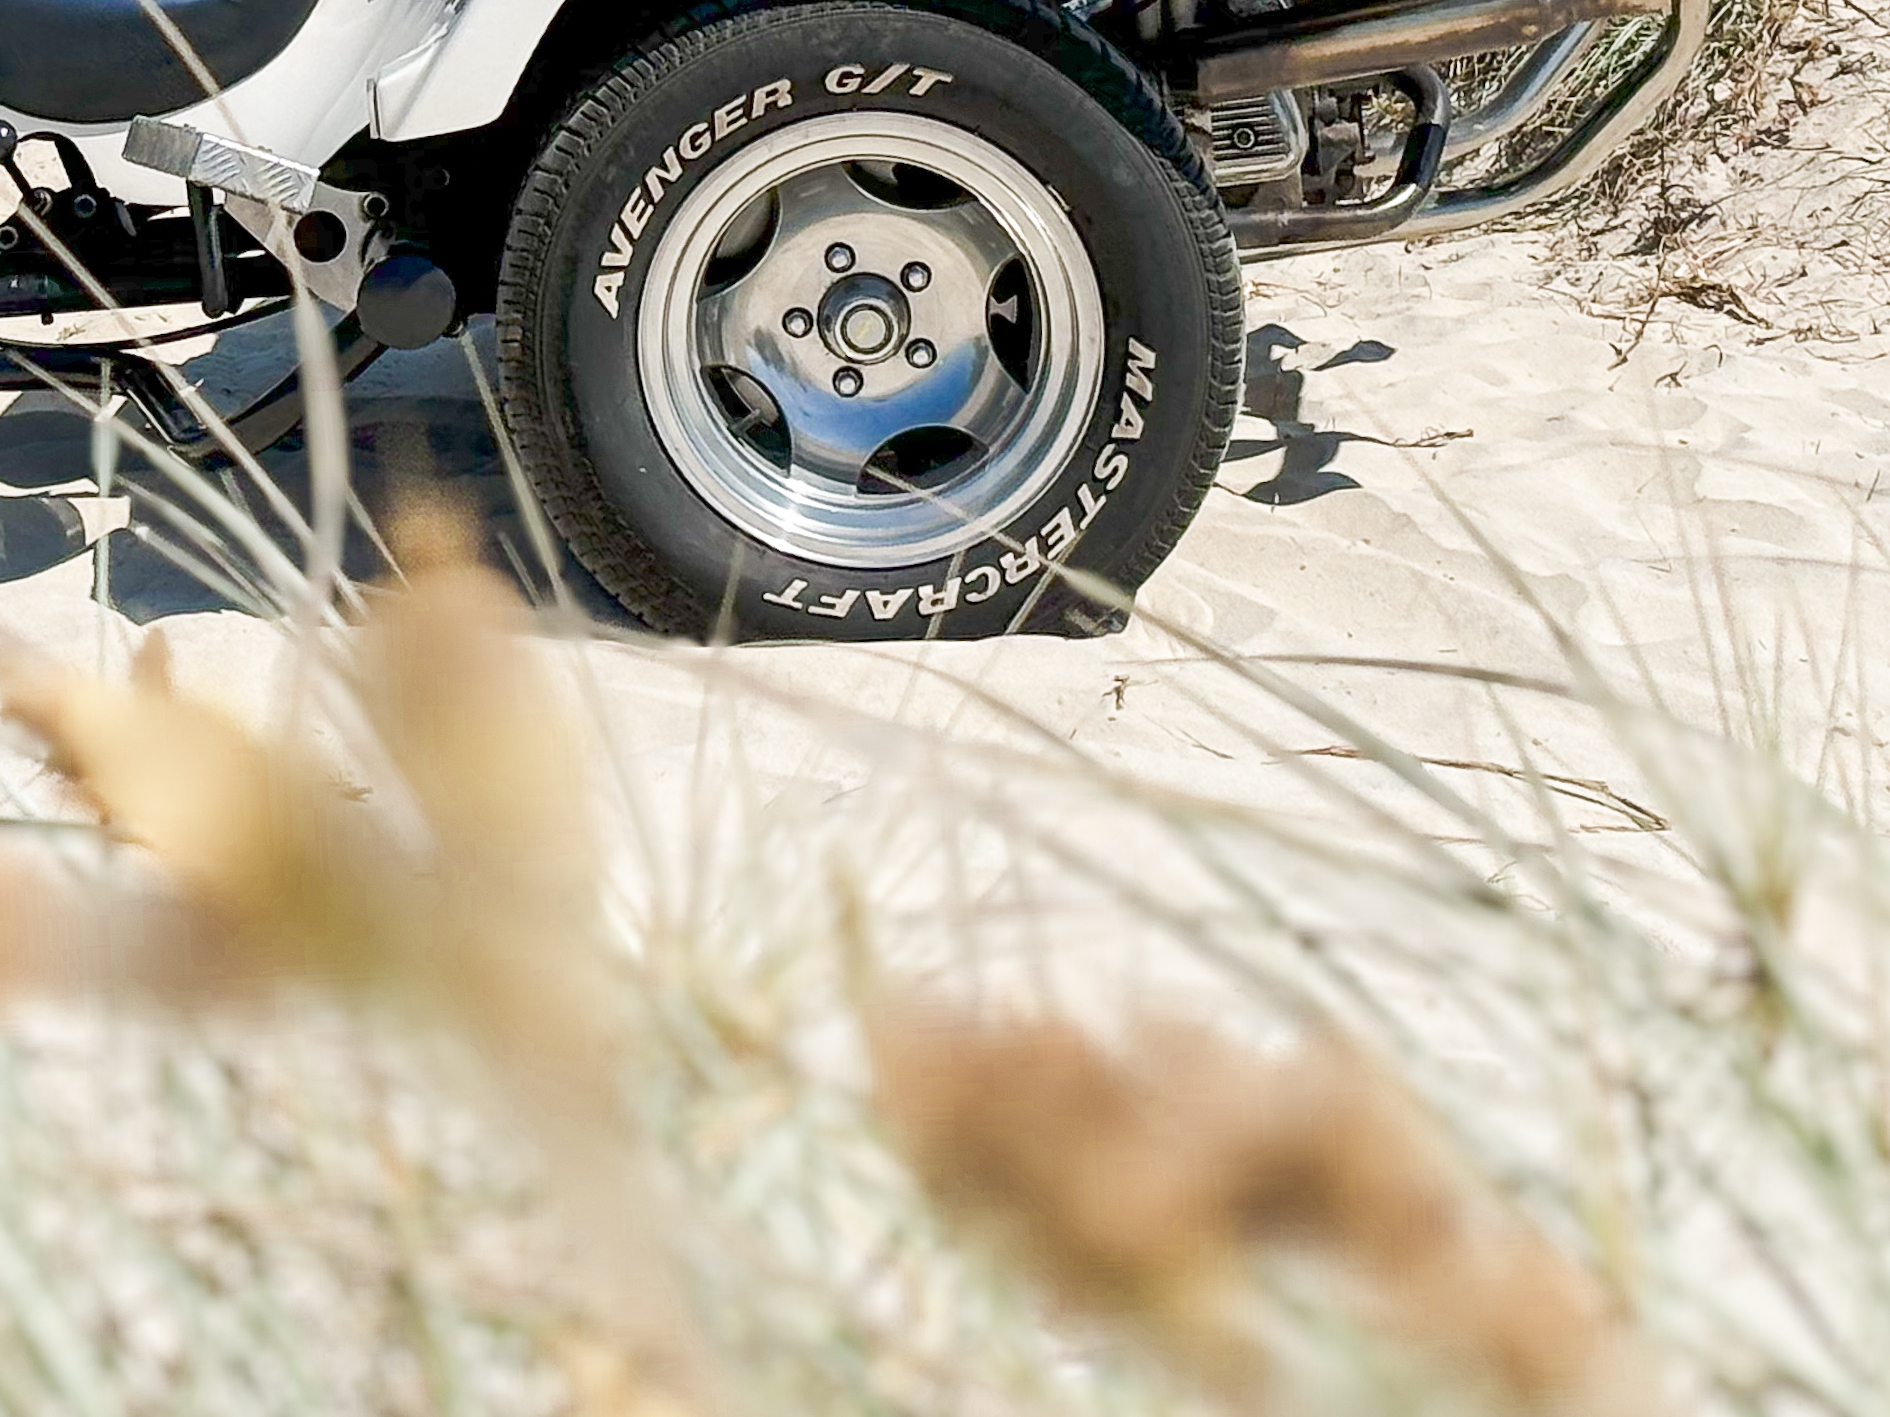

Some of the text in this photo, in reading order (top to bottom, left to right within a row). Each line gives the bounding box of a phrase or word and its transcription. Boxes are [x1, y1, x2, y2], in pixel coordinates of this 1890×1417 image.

[593, 63, 954, 320] AVENGER G/T
[762, 336, 1157, 621] MASTERCRAFT
